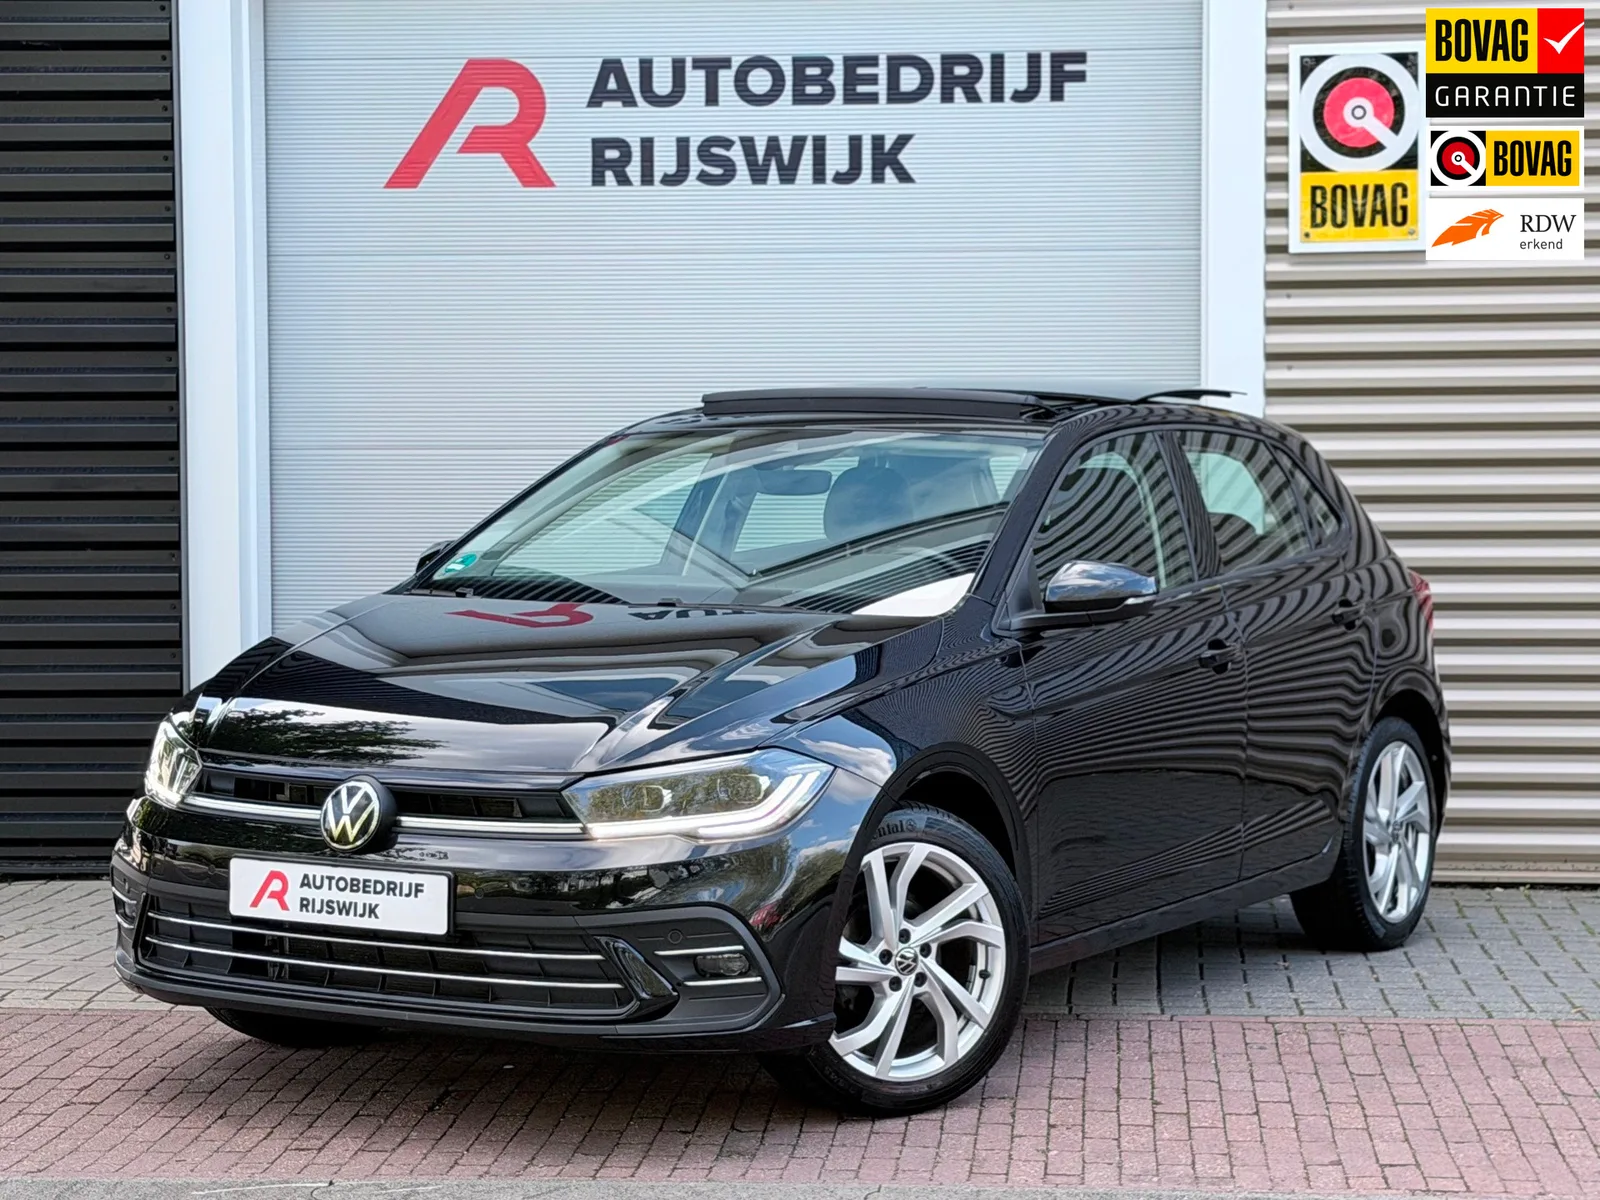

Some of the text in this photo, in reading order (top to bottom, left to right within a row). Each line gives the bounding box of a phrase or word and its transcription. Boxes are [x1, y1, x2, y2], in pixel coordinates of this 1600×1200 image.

[586, 51, 1087, 108] AUTOBEDRIJF
[591, 134, 916, 187] RIJSWIJK
[1309, 182, 1409, 229] BOVAG
[299, 873, 425, 899] AUTOBEDRIJF
[299, 897, 380, 919] RIJSWIJK
